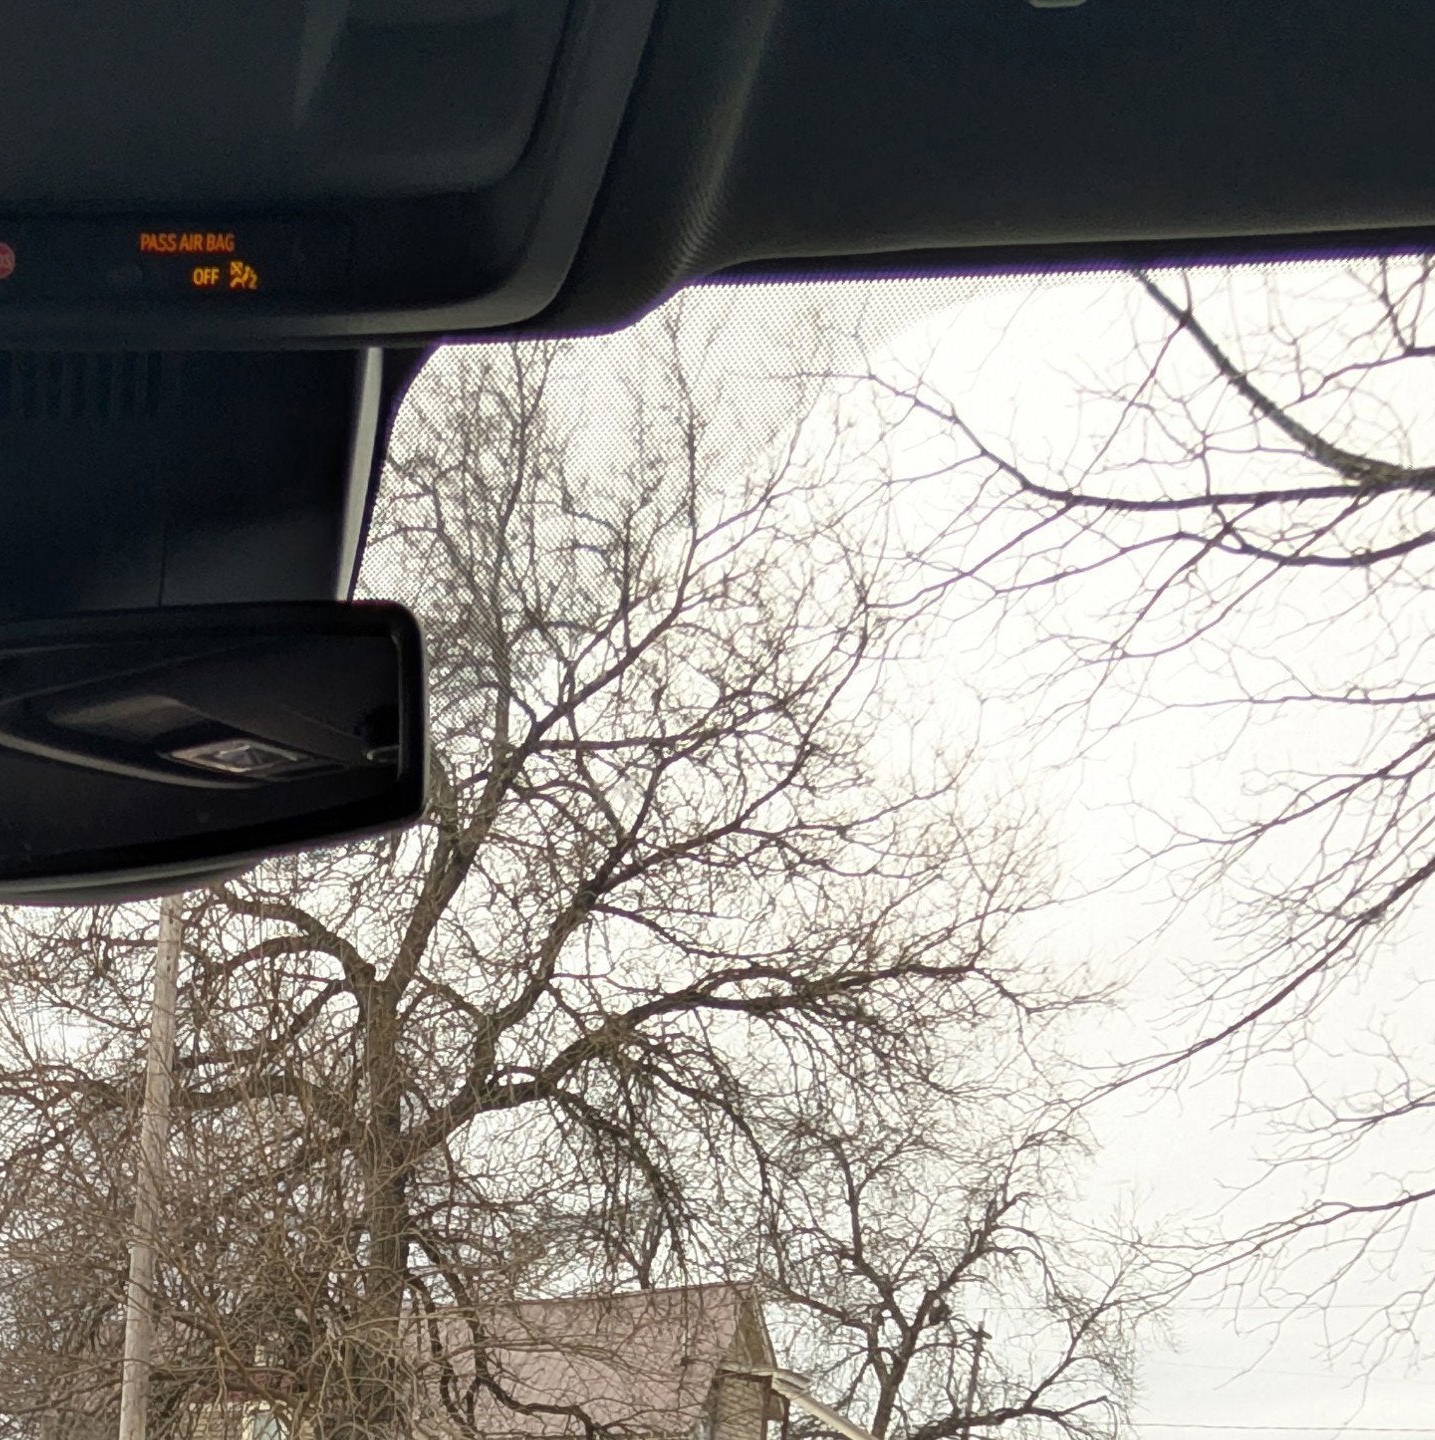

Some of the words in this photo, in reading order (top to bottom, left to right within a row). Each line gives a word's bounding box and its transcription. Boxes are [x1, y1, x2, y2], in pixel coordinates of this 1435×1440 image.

[139, 233, 177, 252] PASS
[179, 234, 204, 251] AIR
[206, 234, 235, 252] BAG
[193, 269, 220, 286] OFF
